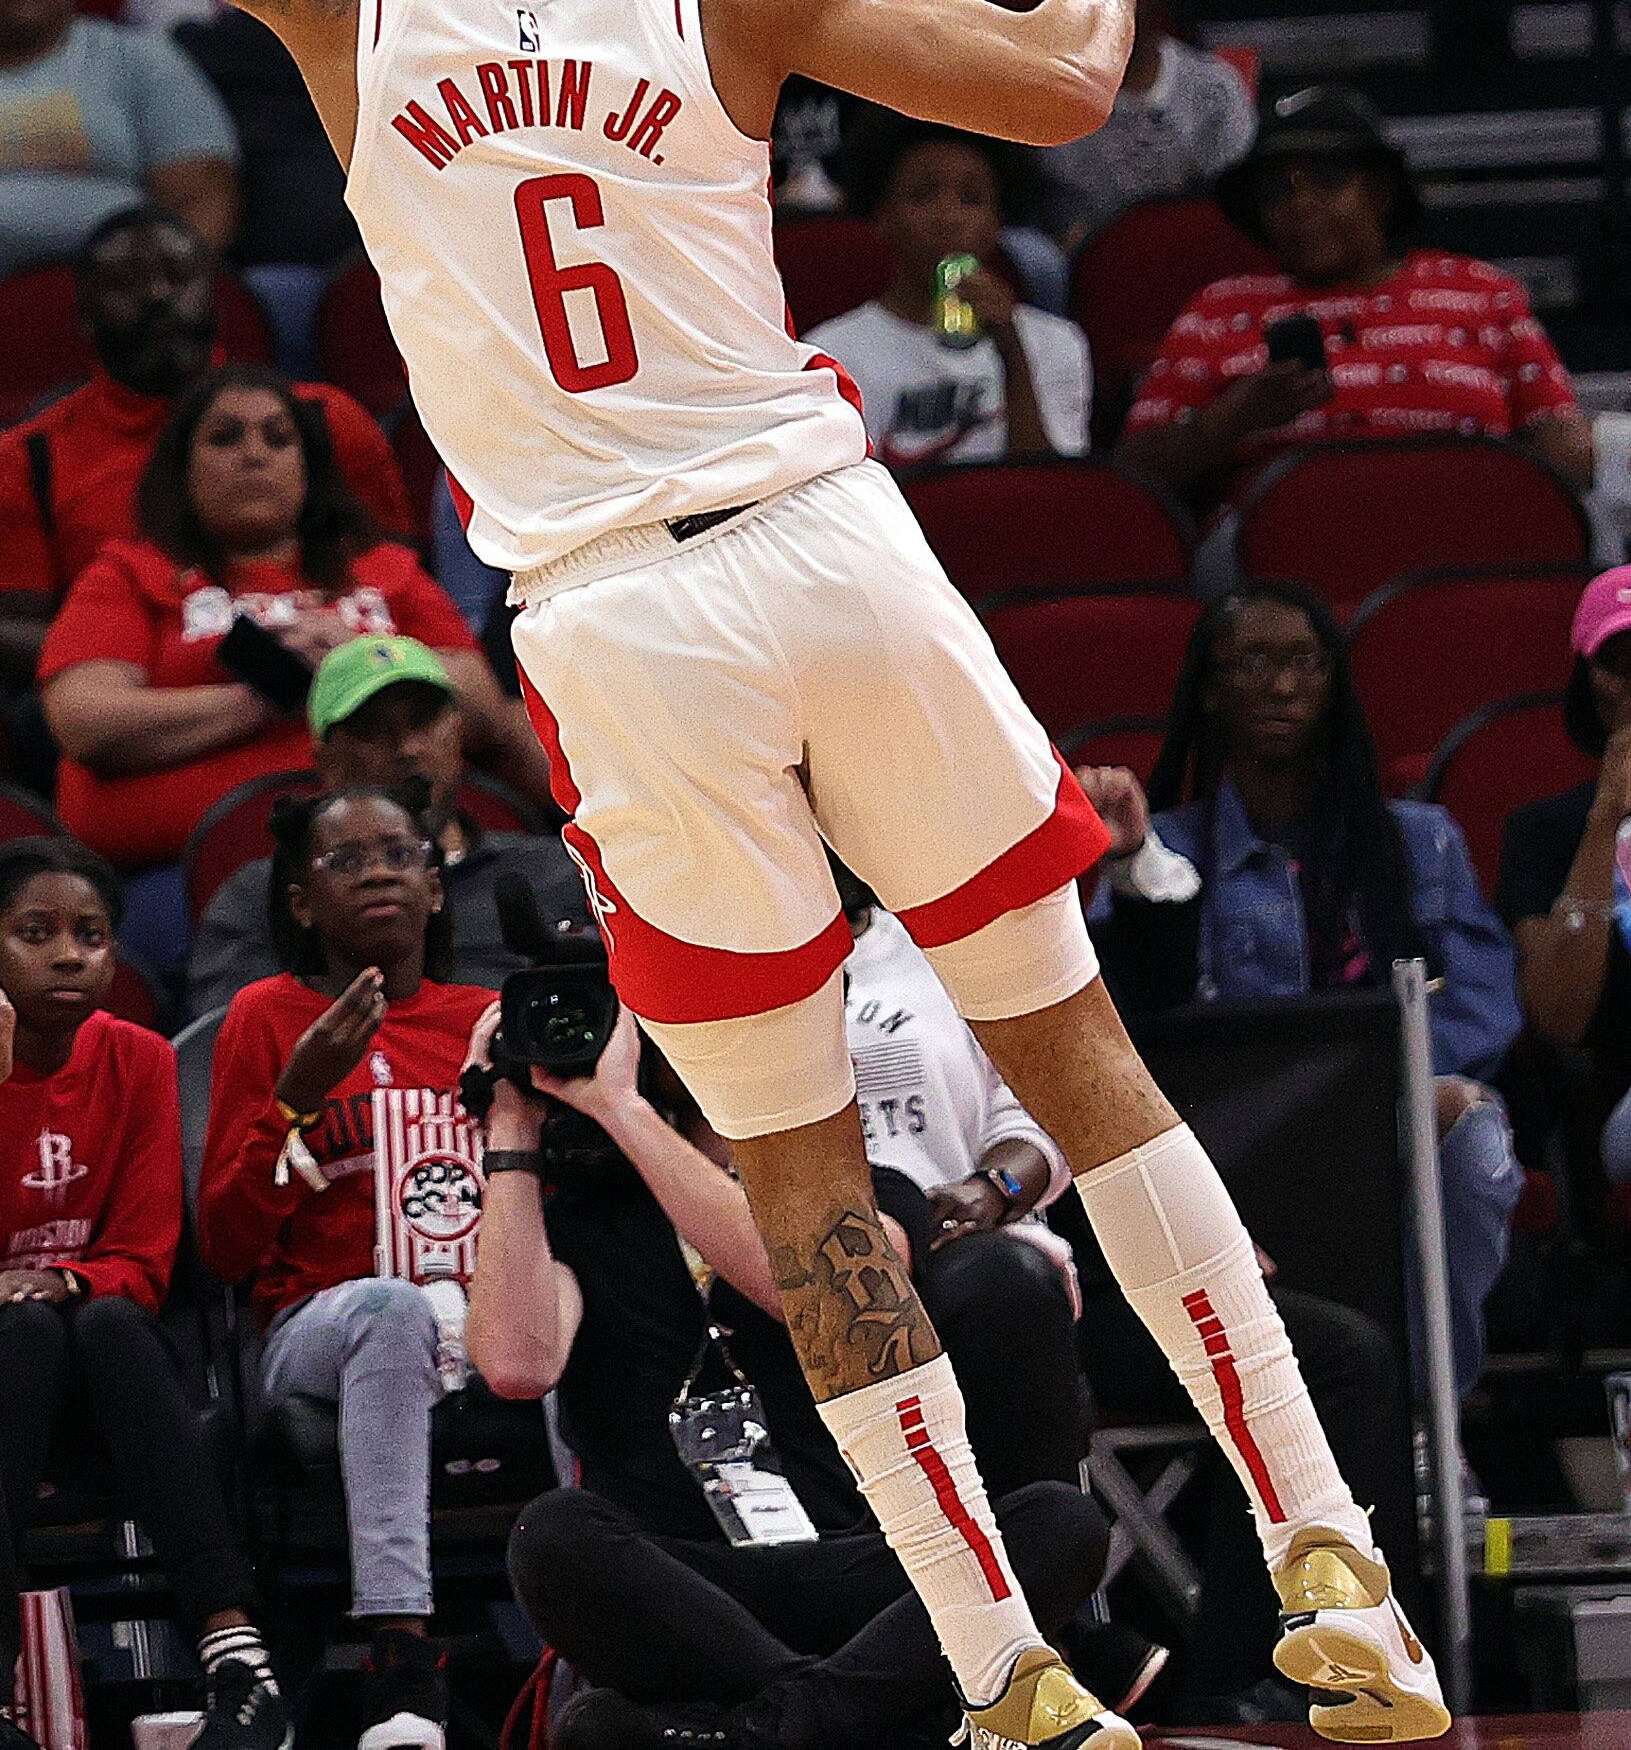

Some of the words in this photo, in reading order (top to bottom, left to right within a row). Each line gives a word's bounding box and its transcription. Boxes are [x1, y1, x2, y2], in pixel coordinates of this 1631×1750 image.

[391, 59, 592, 171] MARTIN
[603, 78, 683, 166] JR.
[514, 173, 639, 393] 6
